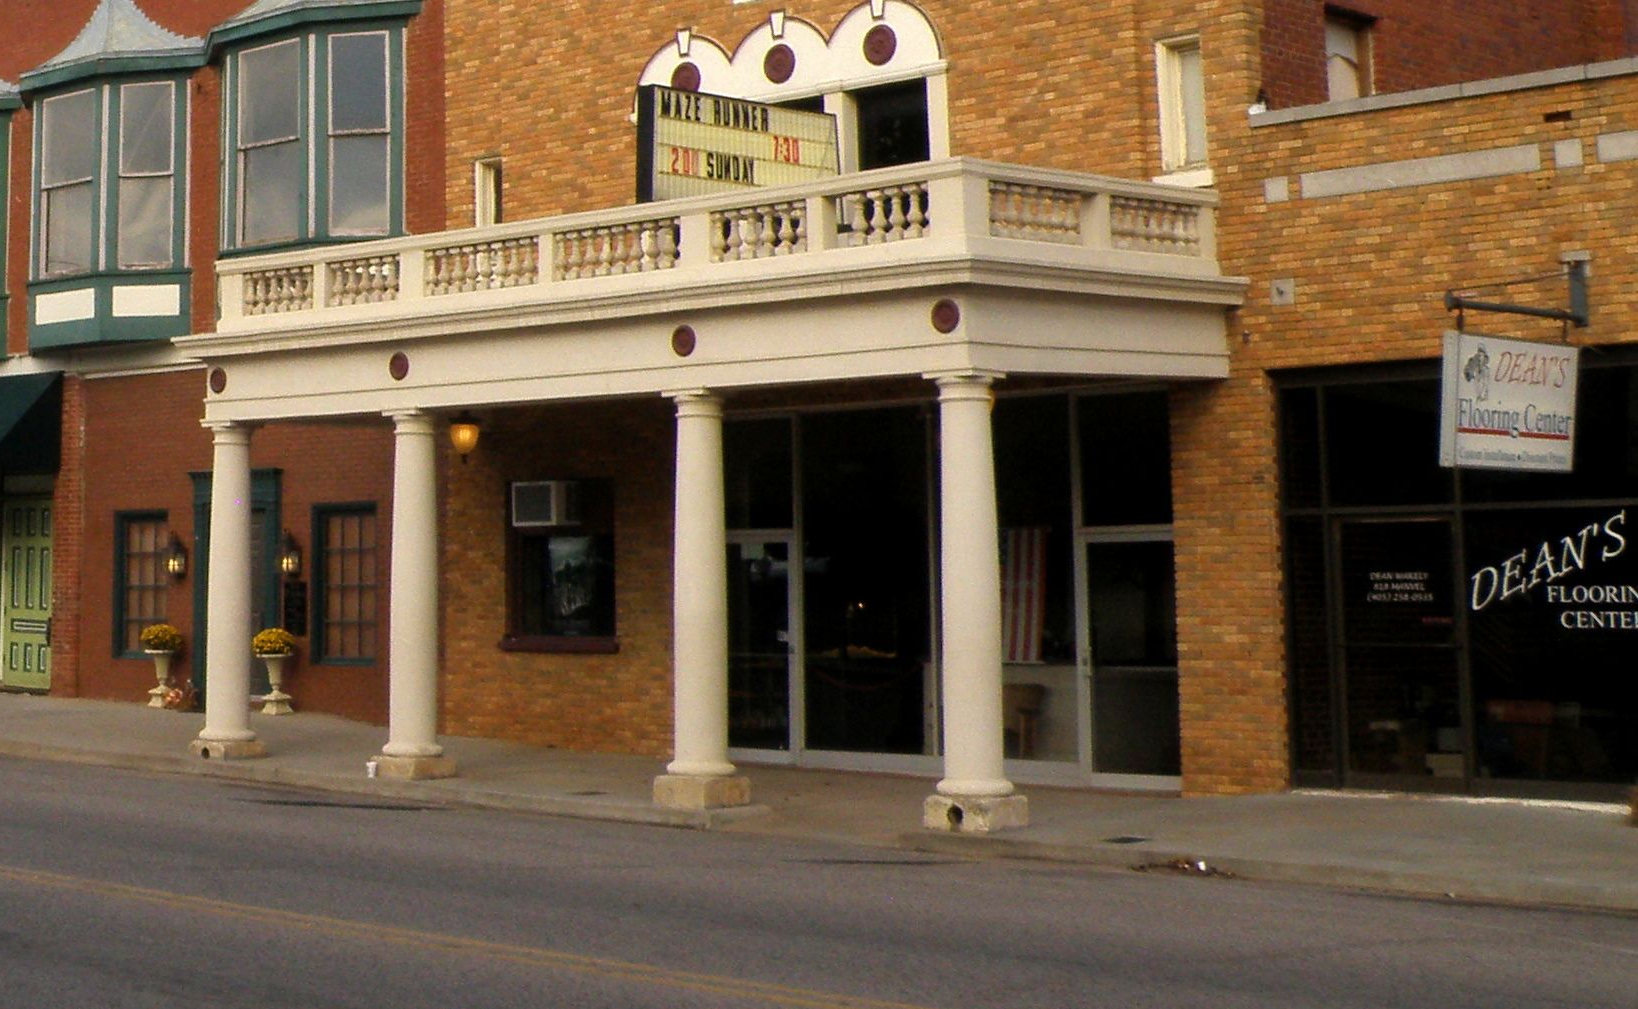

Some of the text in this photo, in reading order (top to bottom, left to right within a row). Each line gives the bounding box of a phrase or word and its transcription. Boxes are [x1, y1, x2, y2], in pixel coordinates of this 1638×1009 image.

[660, 91, 769, 133] MAZE RUNNER
[706, 152, 755, 186] SUNDAY
[1494, 350, 1571, 388] DEAN'S
[1458, 397, 1572, 439] Flooring Center
[1470, 508, 1626, 611] DEAN'S
